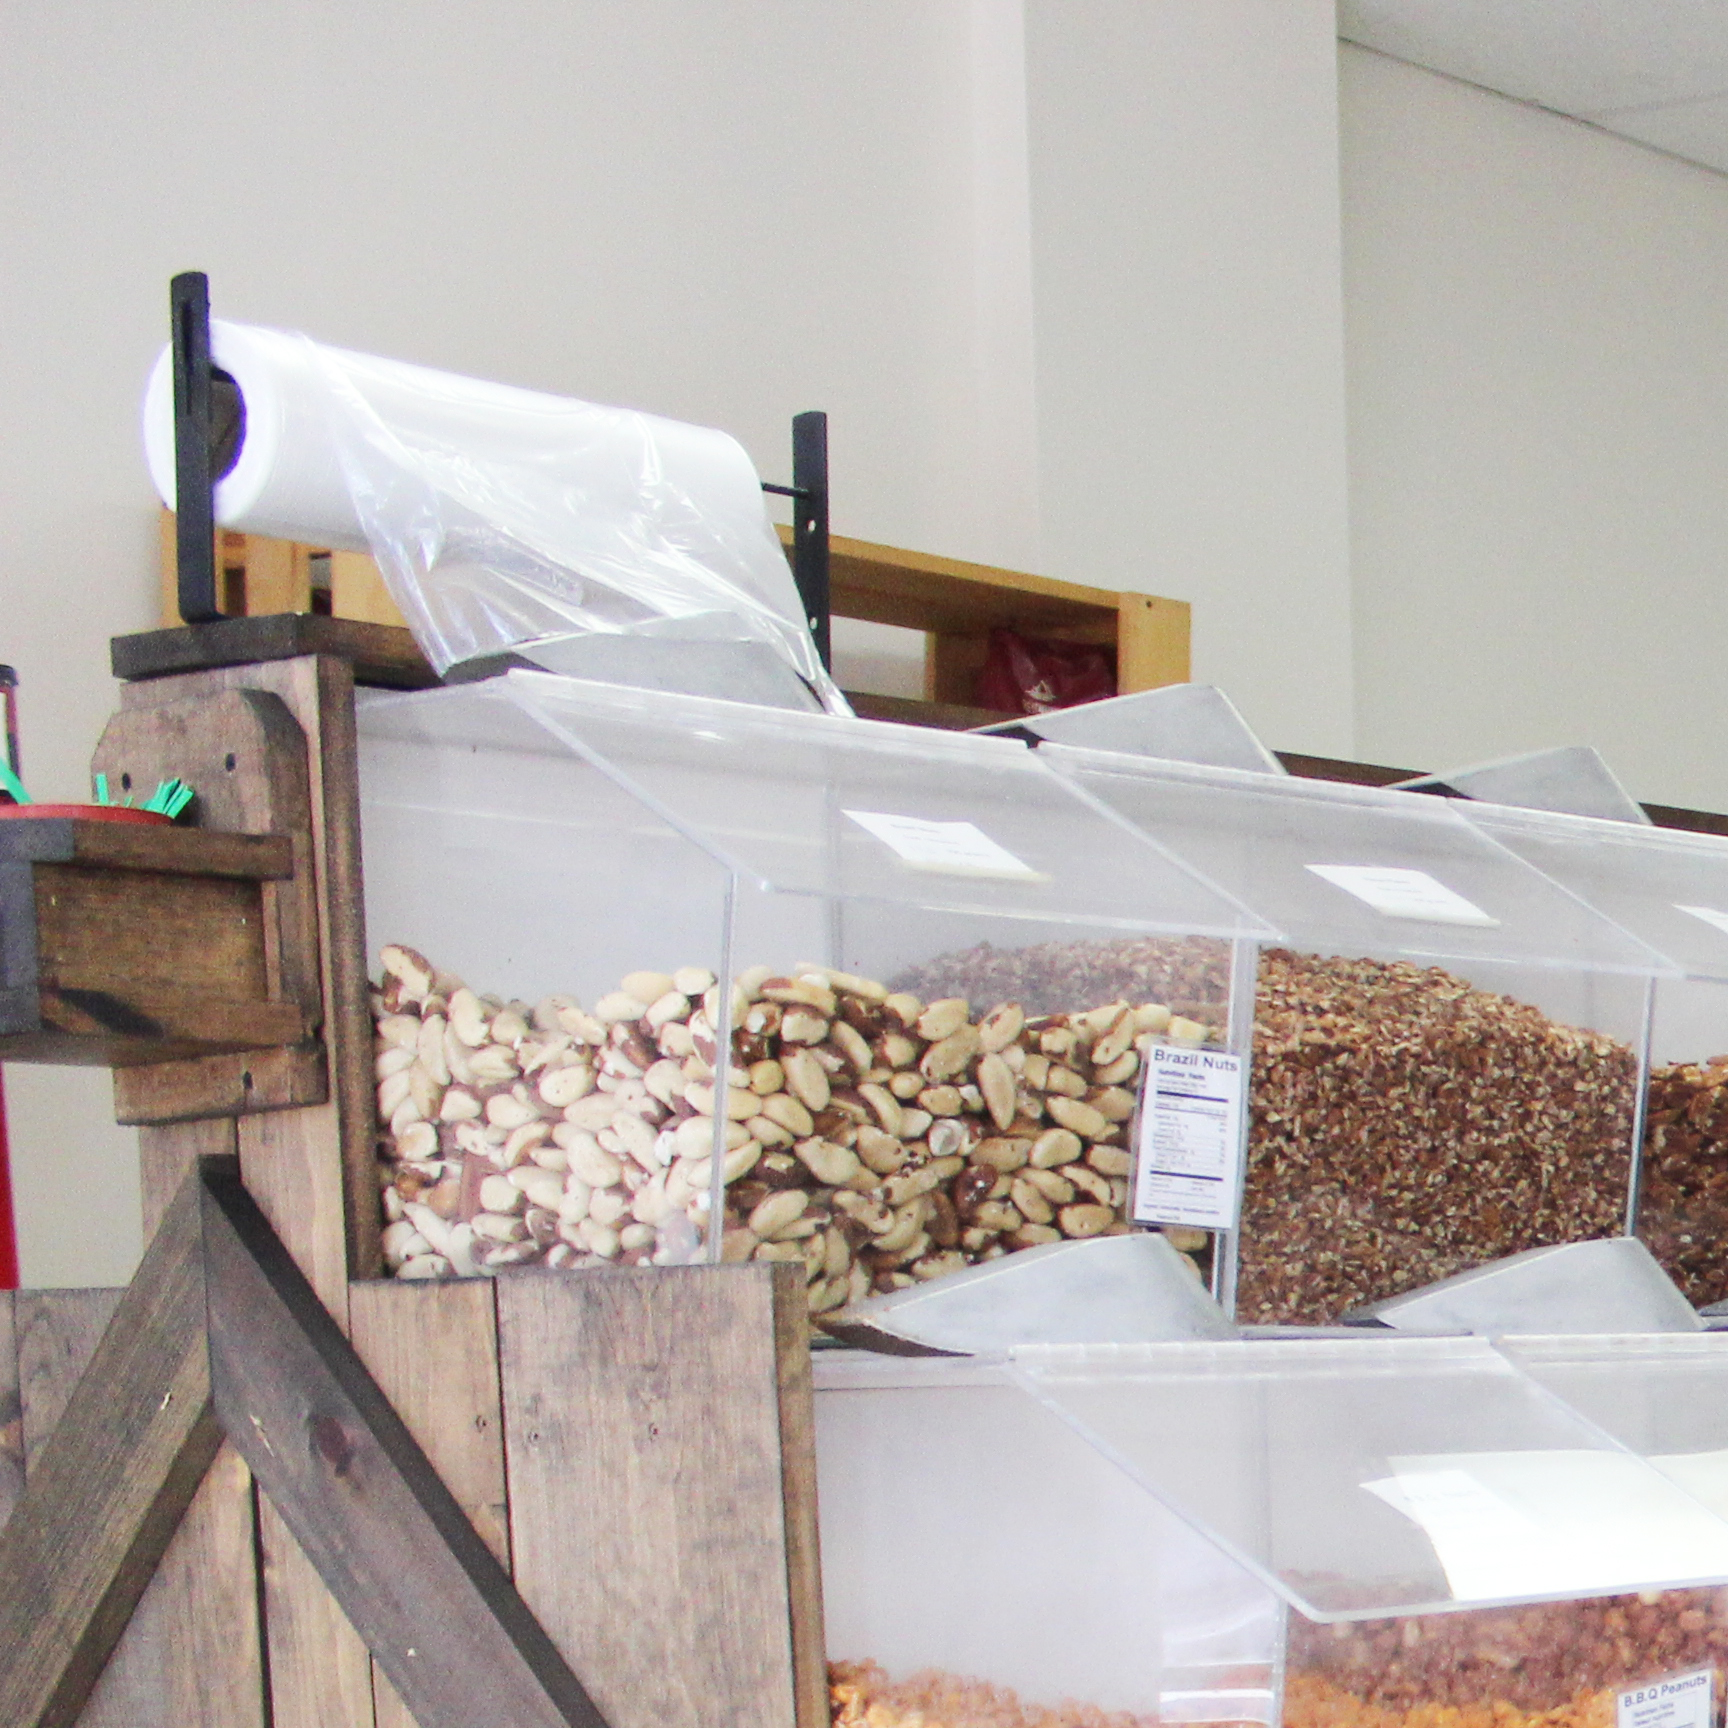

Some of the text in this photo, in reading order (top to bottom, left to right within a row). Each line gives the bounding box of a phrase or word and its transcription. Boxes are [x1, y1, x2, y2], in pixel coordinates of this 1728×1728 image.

[1154, 1048, 1238, 1072] Brazil Nuts
[1660, 1675, 1708, 1697] Peanuts
